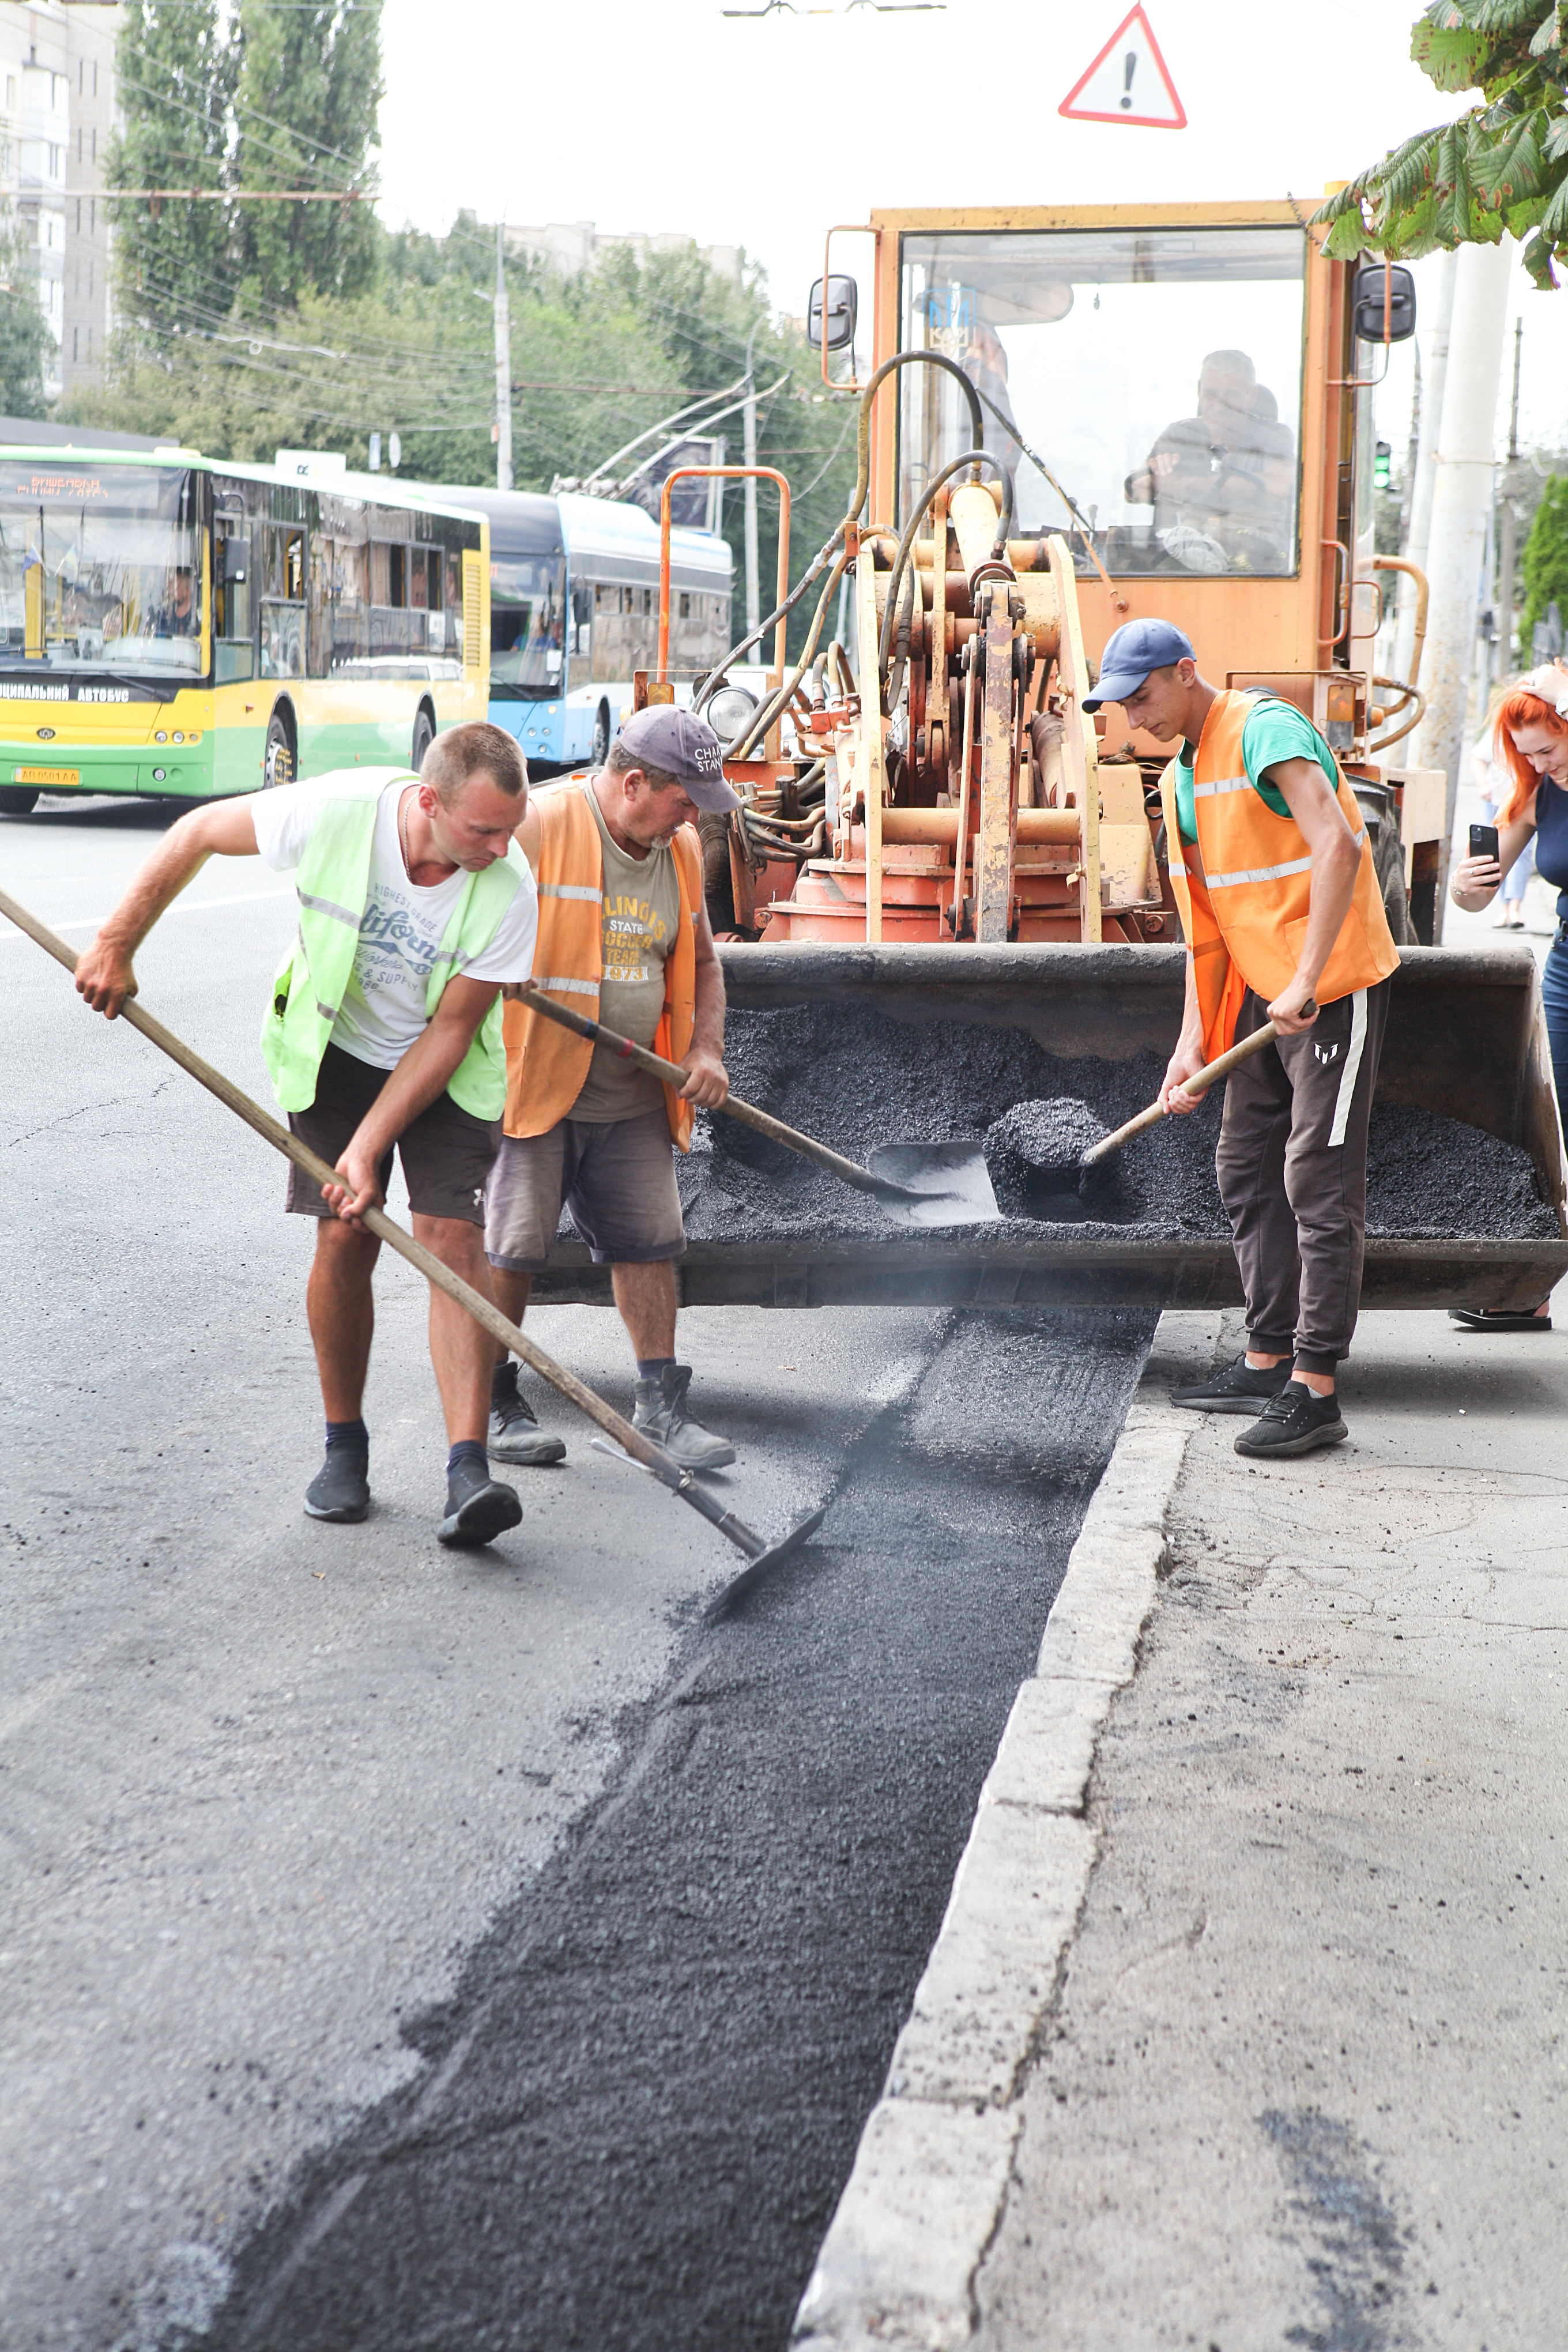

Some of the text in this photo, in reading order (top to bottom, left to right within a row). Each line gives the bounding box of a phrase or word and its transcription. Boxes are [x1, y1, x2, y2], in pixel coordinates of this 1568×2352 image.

[78, 687, 130, 702] АВТОБУС
[375, 883, 411, 909] HIGHEST
[411, 909, 438, 932] GRADE
[602, 896, 666, 940] LINOIS
[609, 919, 643, 934] STATE
[606, 948, 639, 966] TEAM
[364, 968, 374, 979] &
[377, 971, 419, 992] SUPPLY
